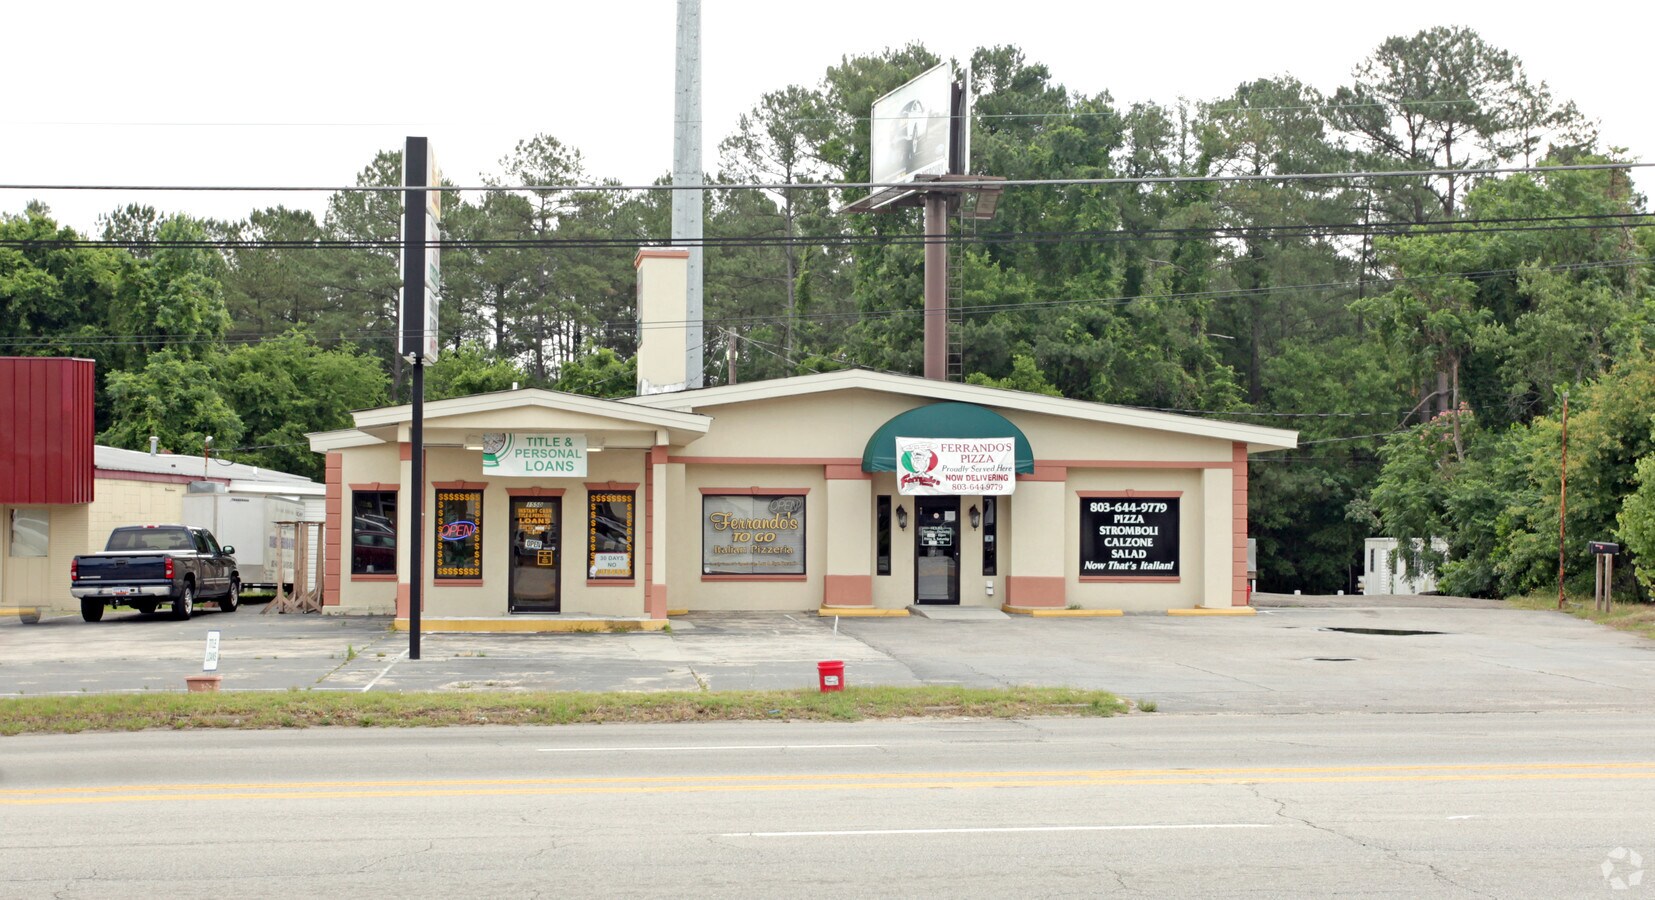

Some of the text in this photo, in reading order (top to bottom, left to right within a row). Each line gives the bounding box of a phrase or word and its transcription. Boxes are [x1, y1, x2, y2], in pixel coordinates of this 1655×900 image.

[526, 437, 573, 447] TITLE &
[941, 443, 1012, 453] FERRANDO'S
[515, 448, 582, 459] PERSONAL
[960, 454, 994, 463] PIZZA
[525, 460, 574, 472] LOANS
[942, 465, 969, 473] Proudly
[996, 464, 1012, 472] Here
[966, 474, 1009, 482] DELIVERING
[770, 499, 799, 512] OPEN
[1090, 502, 1167, 513] 803-644-9779
[709, 511, 798, 531] Ferrando's
[1113, 514, 1145, 523] PIZZA
[440, 524, 473, 537] OPEN
[1099, 526, 1158, 535] STROMBOLI
[733, 532, 776, 542] TO GO
[1104, 538, 1153, 547] CALZONE
[714, 545, 793, 554] Italian Pizzeria
[1111, 549, 1147, 558] SALAD
[1084, 561, 1106, 570] Now
[1108, 561, 1137, 570] That's
